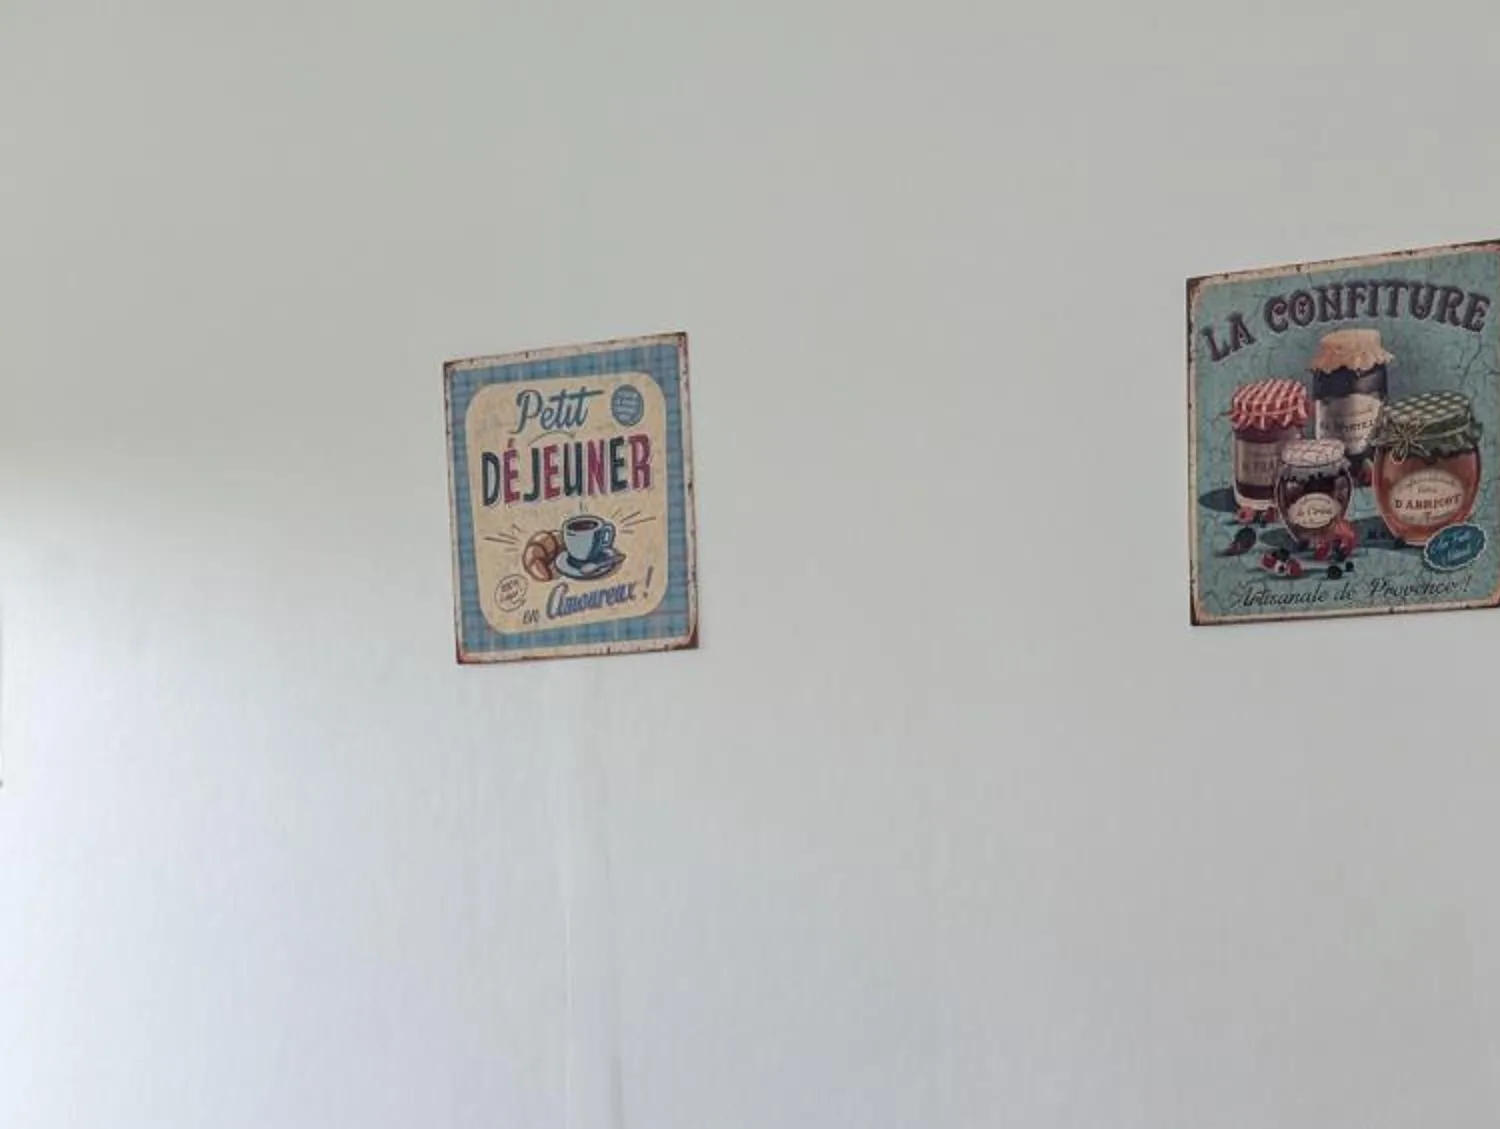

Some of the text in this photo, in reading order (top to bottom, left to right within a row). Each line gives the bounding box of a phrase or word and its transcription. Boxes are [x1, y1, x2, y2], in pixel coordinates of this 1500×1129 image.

[1199, 279, 1492, 362] LA CONFITURE
[509, 387, 605, 435] Petit
[481, 431, 654, 507] DÉJEUNER
